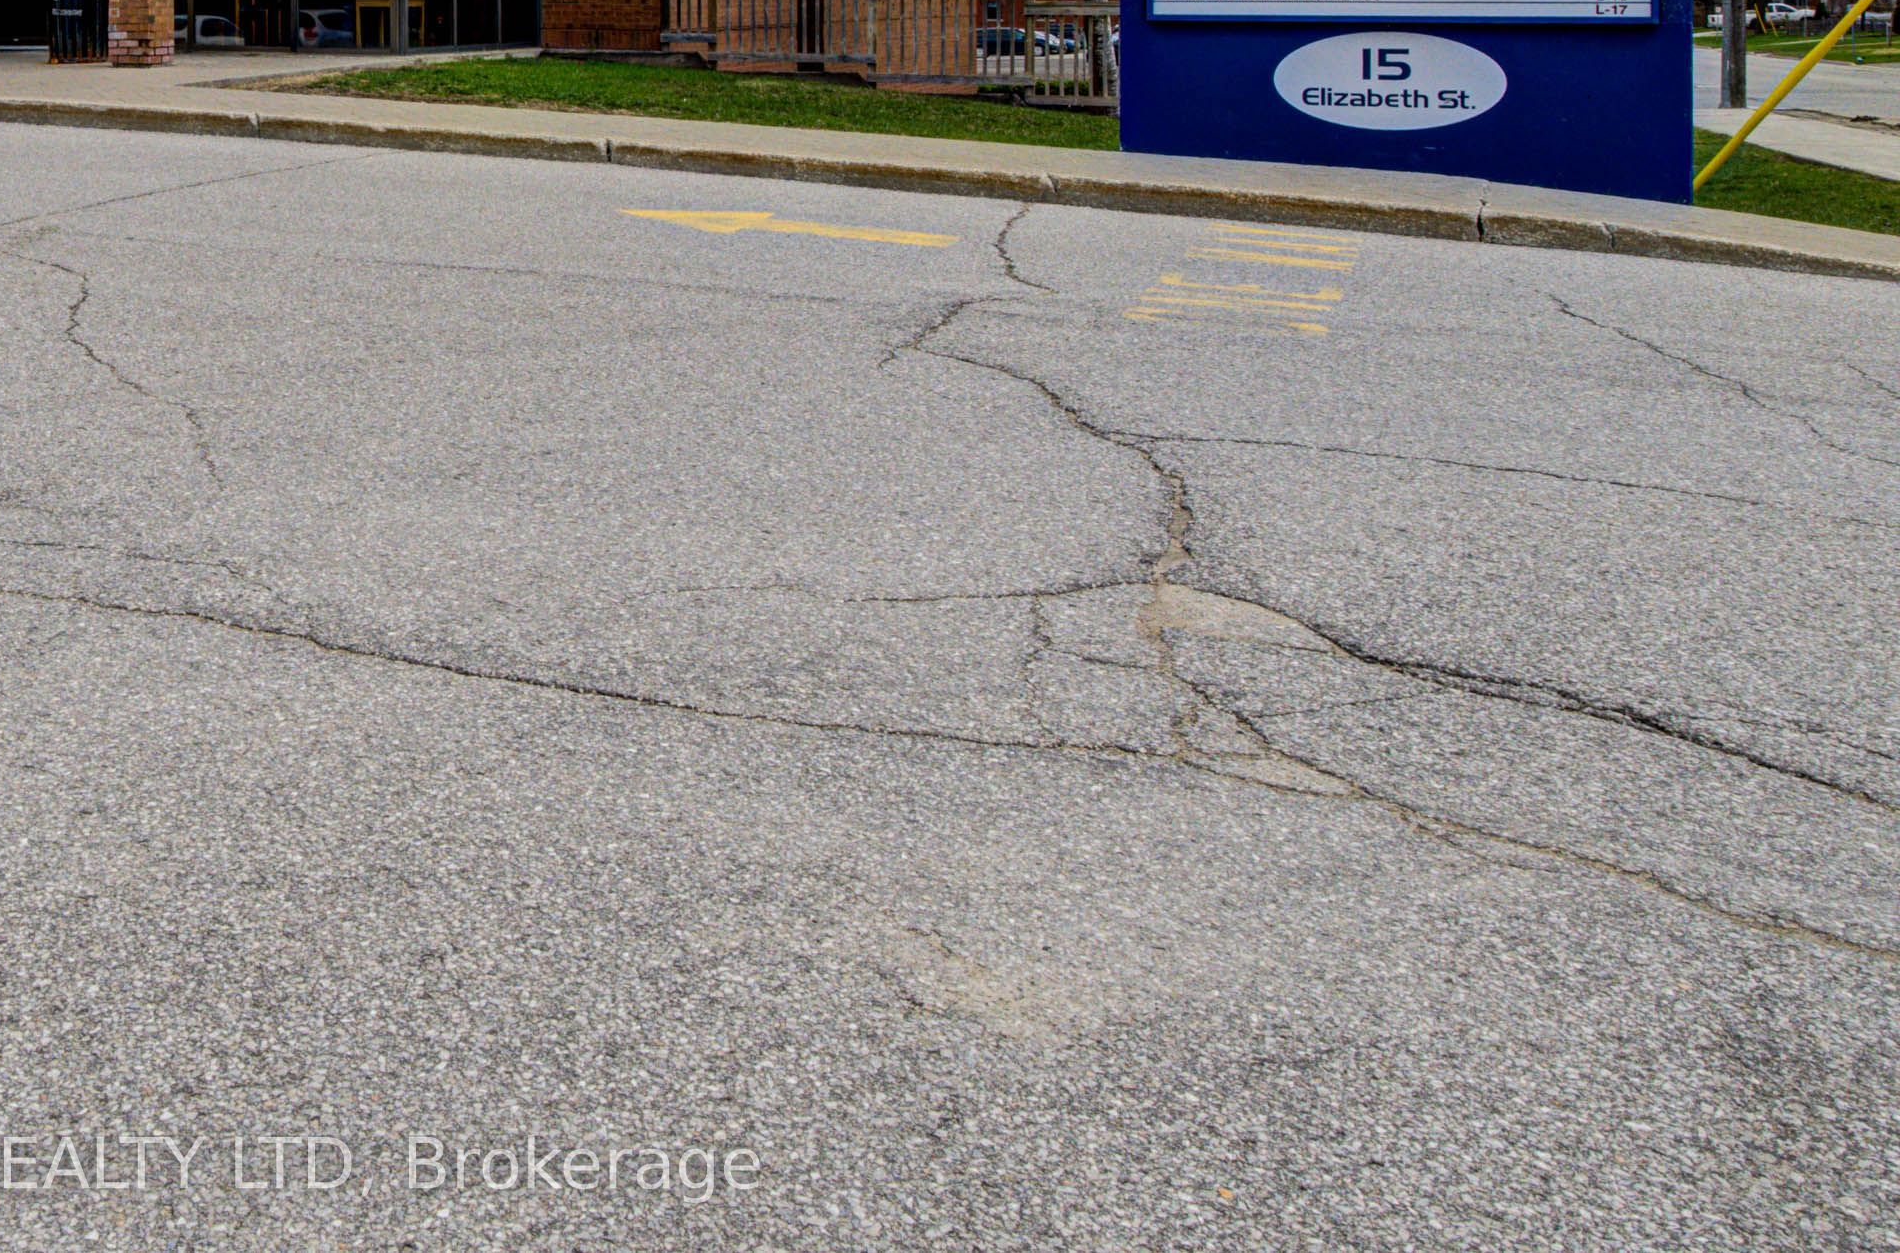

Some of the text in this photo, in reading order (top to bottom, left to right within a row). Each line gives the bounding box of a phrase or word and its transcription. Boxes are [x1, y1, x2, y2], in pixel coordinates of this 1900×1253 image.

[1596, 5, 1628, 15] L-17
[1362, 48, 1412, 81] 15
[1302, 87, 1476, 109] Elizabeth St.
